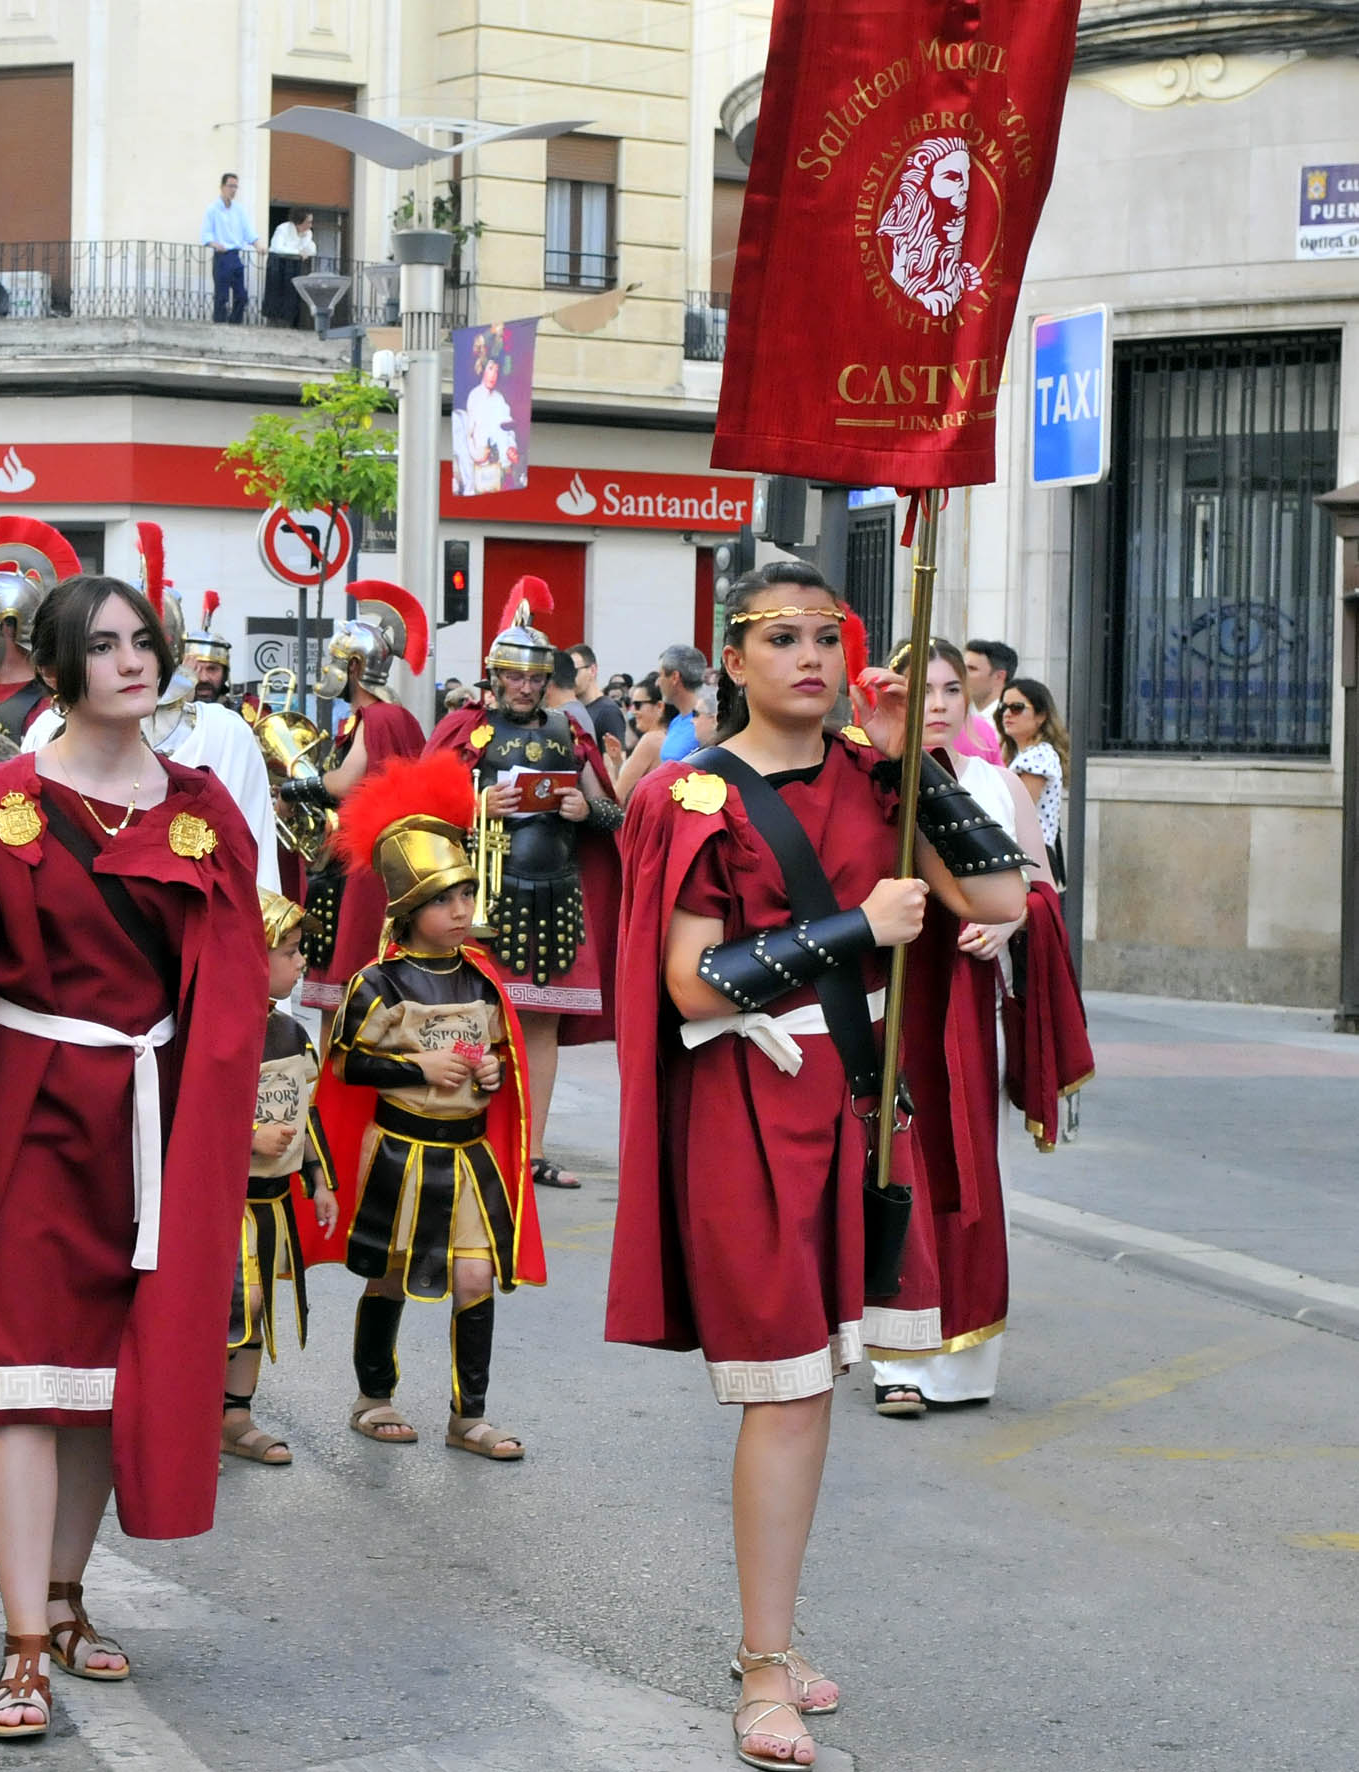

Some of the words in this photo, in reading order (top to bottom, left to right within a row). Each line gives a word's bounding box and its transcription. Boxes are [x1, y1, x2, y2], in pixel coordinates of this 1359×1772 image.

[796, 57, 912, 181] Salutem
[854, 136, 902, 238] FIESTAS
[1310, 202, 1359, 220] PUEN
[1036, 367, 1101, 427] TAXI
[899, 410, 978, 432] LINARES
[602, 482, 748, 522] Santander
[257, 1089, 292, 1104] SPQR
